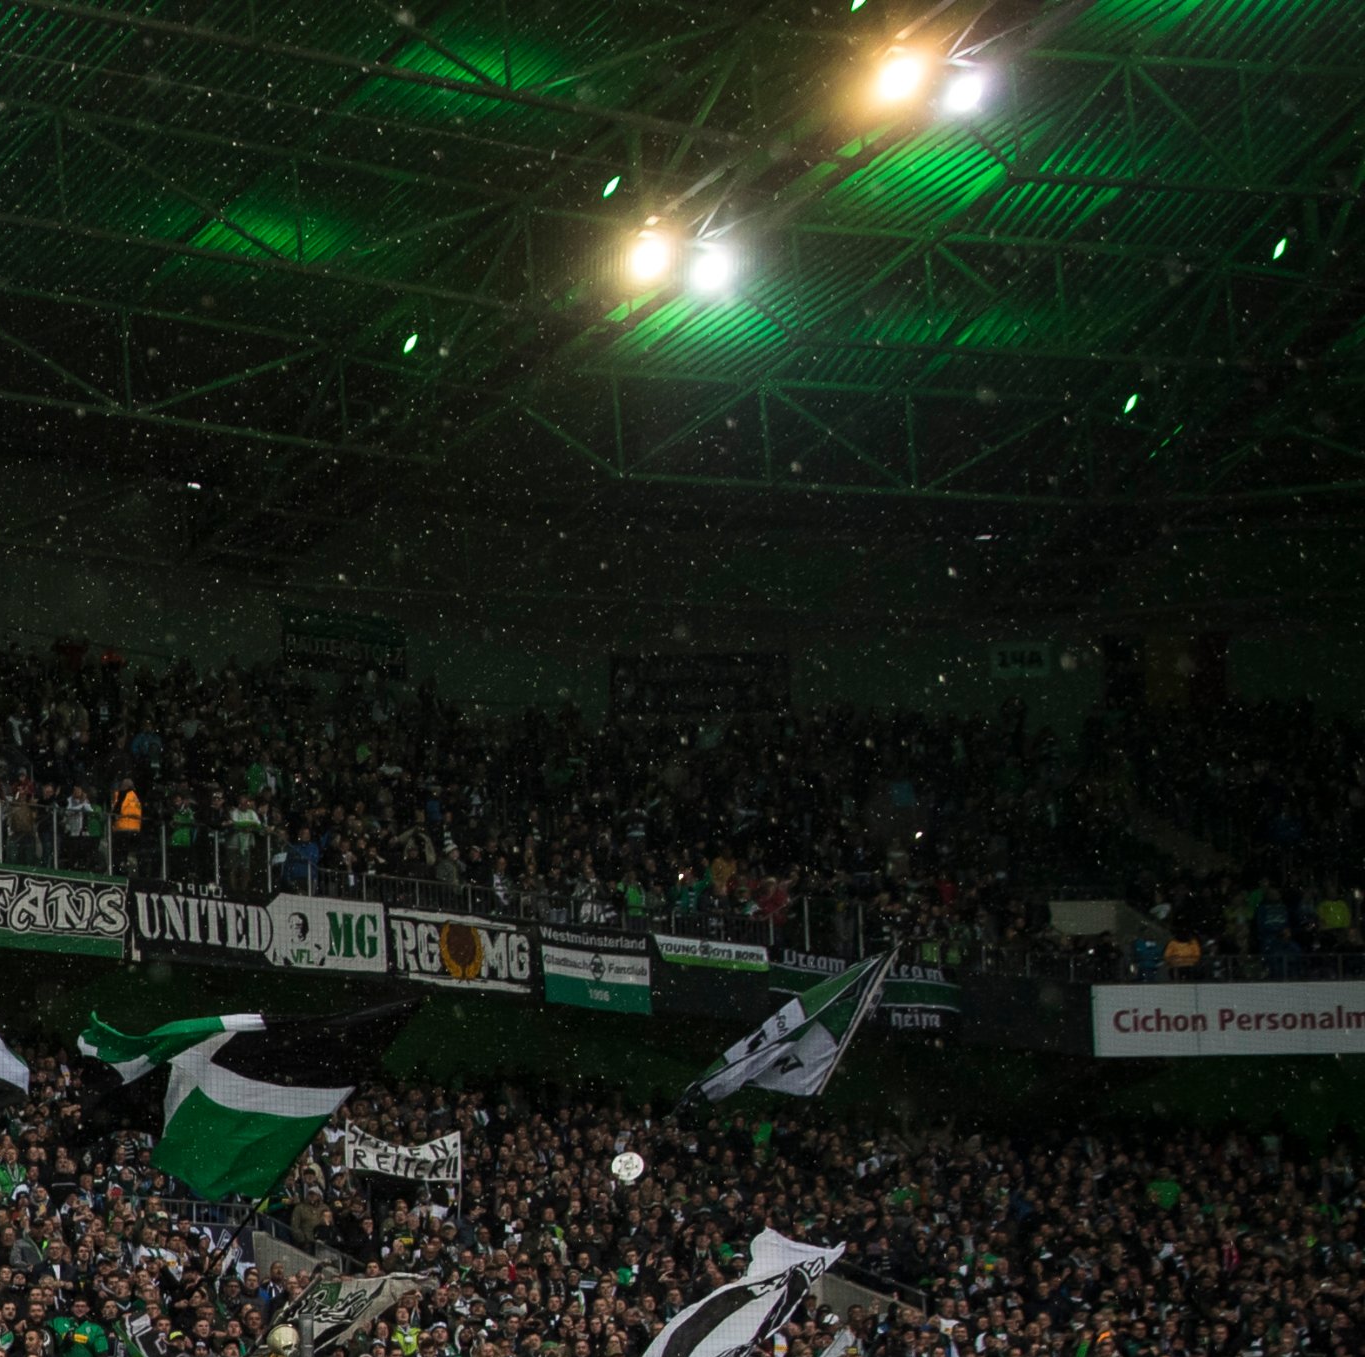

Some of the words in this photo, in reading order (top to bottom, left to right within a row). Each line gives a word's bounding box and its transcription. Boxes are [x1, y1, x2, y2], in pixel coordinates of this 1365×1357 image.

[134, 891, 272, 953] UNITED
[325, 911, 379, 958] MG
[539, 925, 647, 951] Westmünsterland
[389, 919, 442, 972] RG
[481, 930, 531, 980] MG
[544, 953, 591, 975] Gladbach
[1113, 1008, 1208, 1033] Cichon
